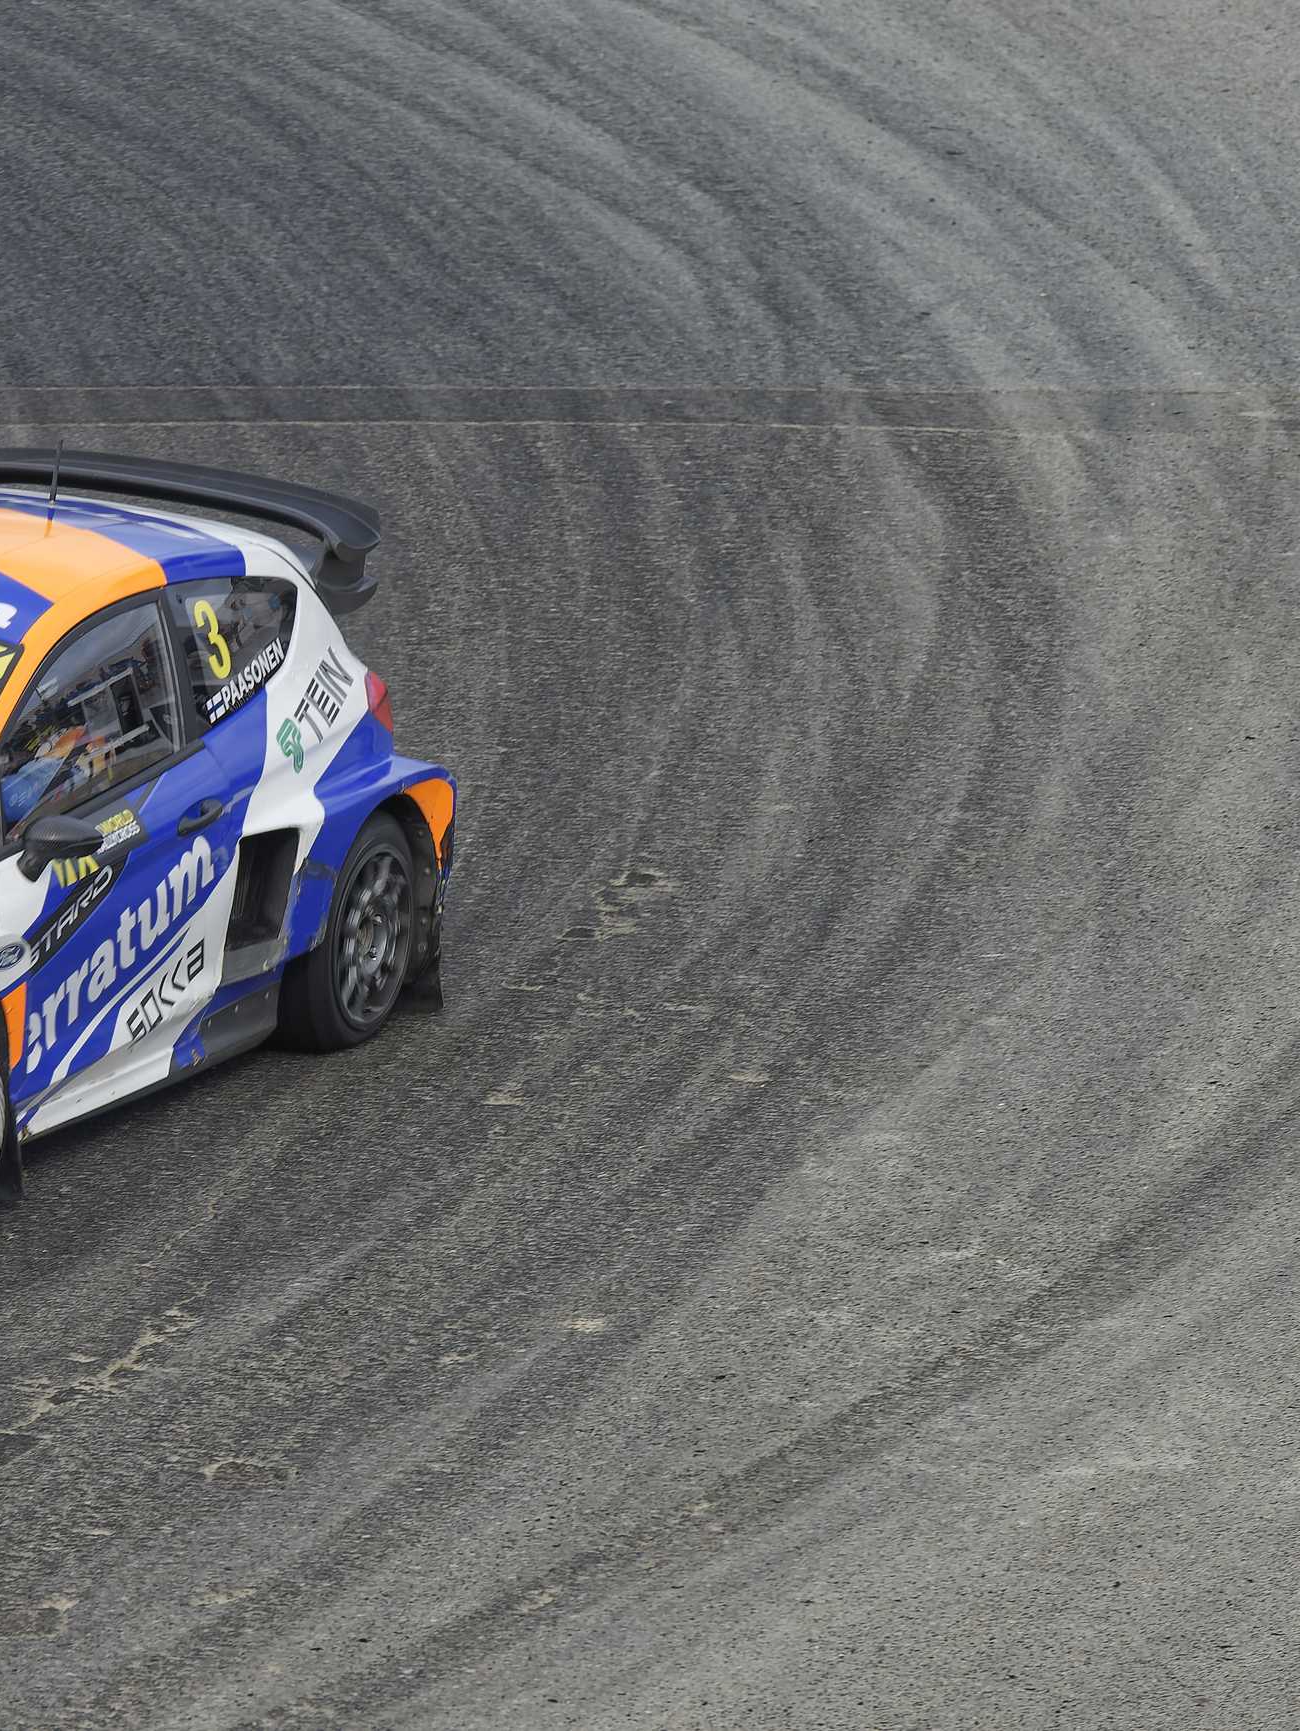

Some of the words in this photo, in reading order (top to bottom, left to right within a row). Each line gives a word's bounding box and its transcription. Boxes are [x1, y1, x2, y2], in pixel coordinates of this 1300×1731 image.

[193, 600, 231, 679] 3
[219, 637, 285, 710] PAASONEN
[294, 646, 354, 744] TEIN
[26, 836, 215, 1074] erratum
